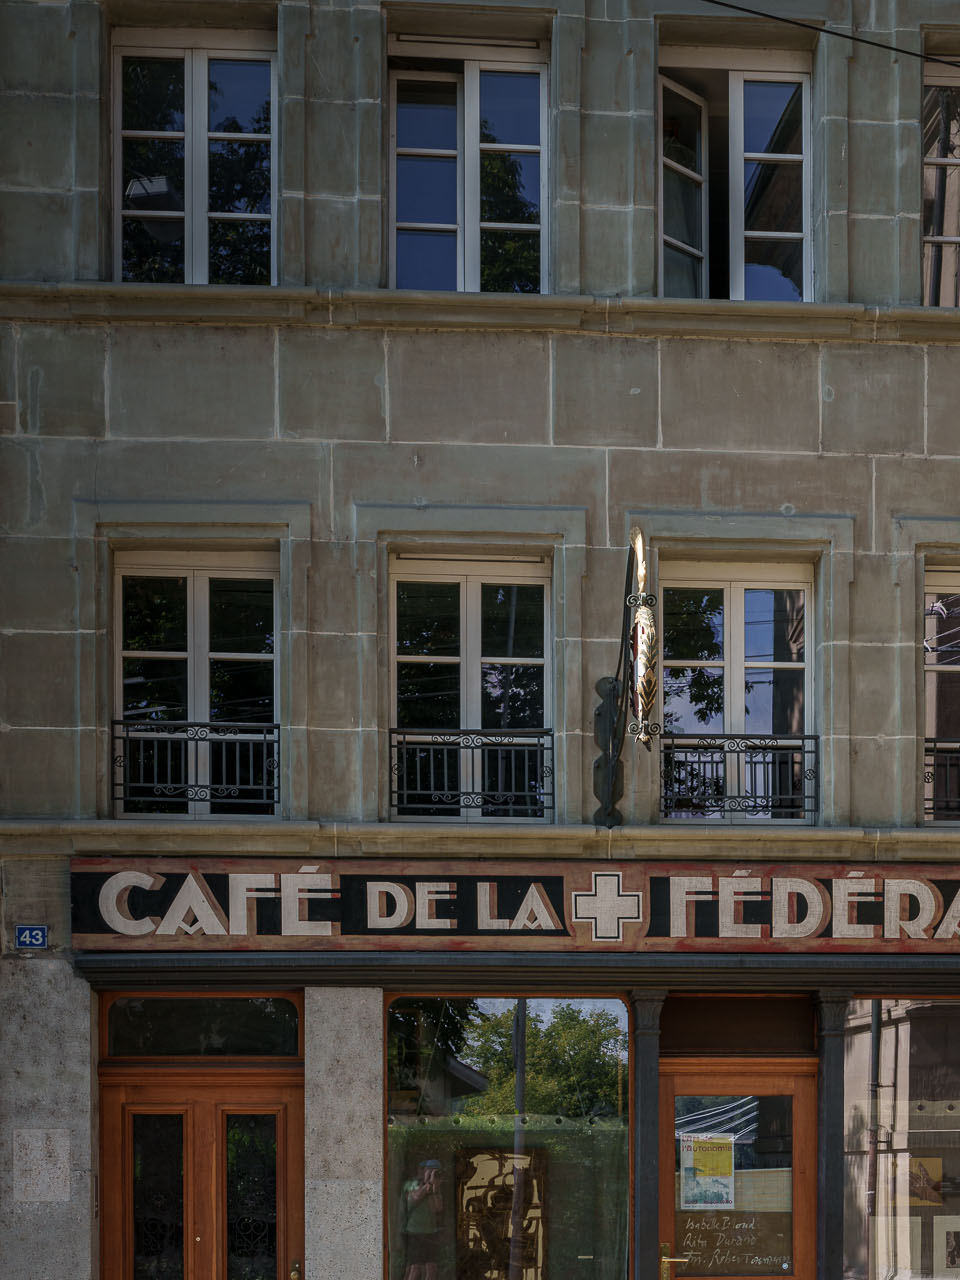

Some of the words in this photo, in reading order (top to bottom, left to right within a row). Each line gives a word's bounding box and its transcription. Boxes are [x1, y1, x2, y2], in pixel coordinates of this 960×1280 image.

[99, 866, 341, 937] CAFÉ
[366, 881, 457, 930] DE
[477, 881, 563, 930] LA
[19, 929, 44, 945] 43
